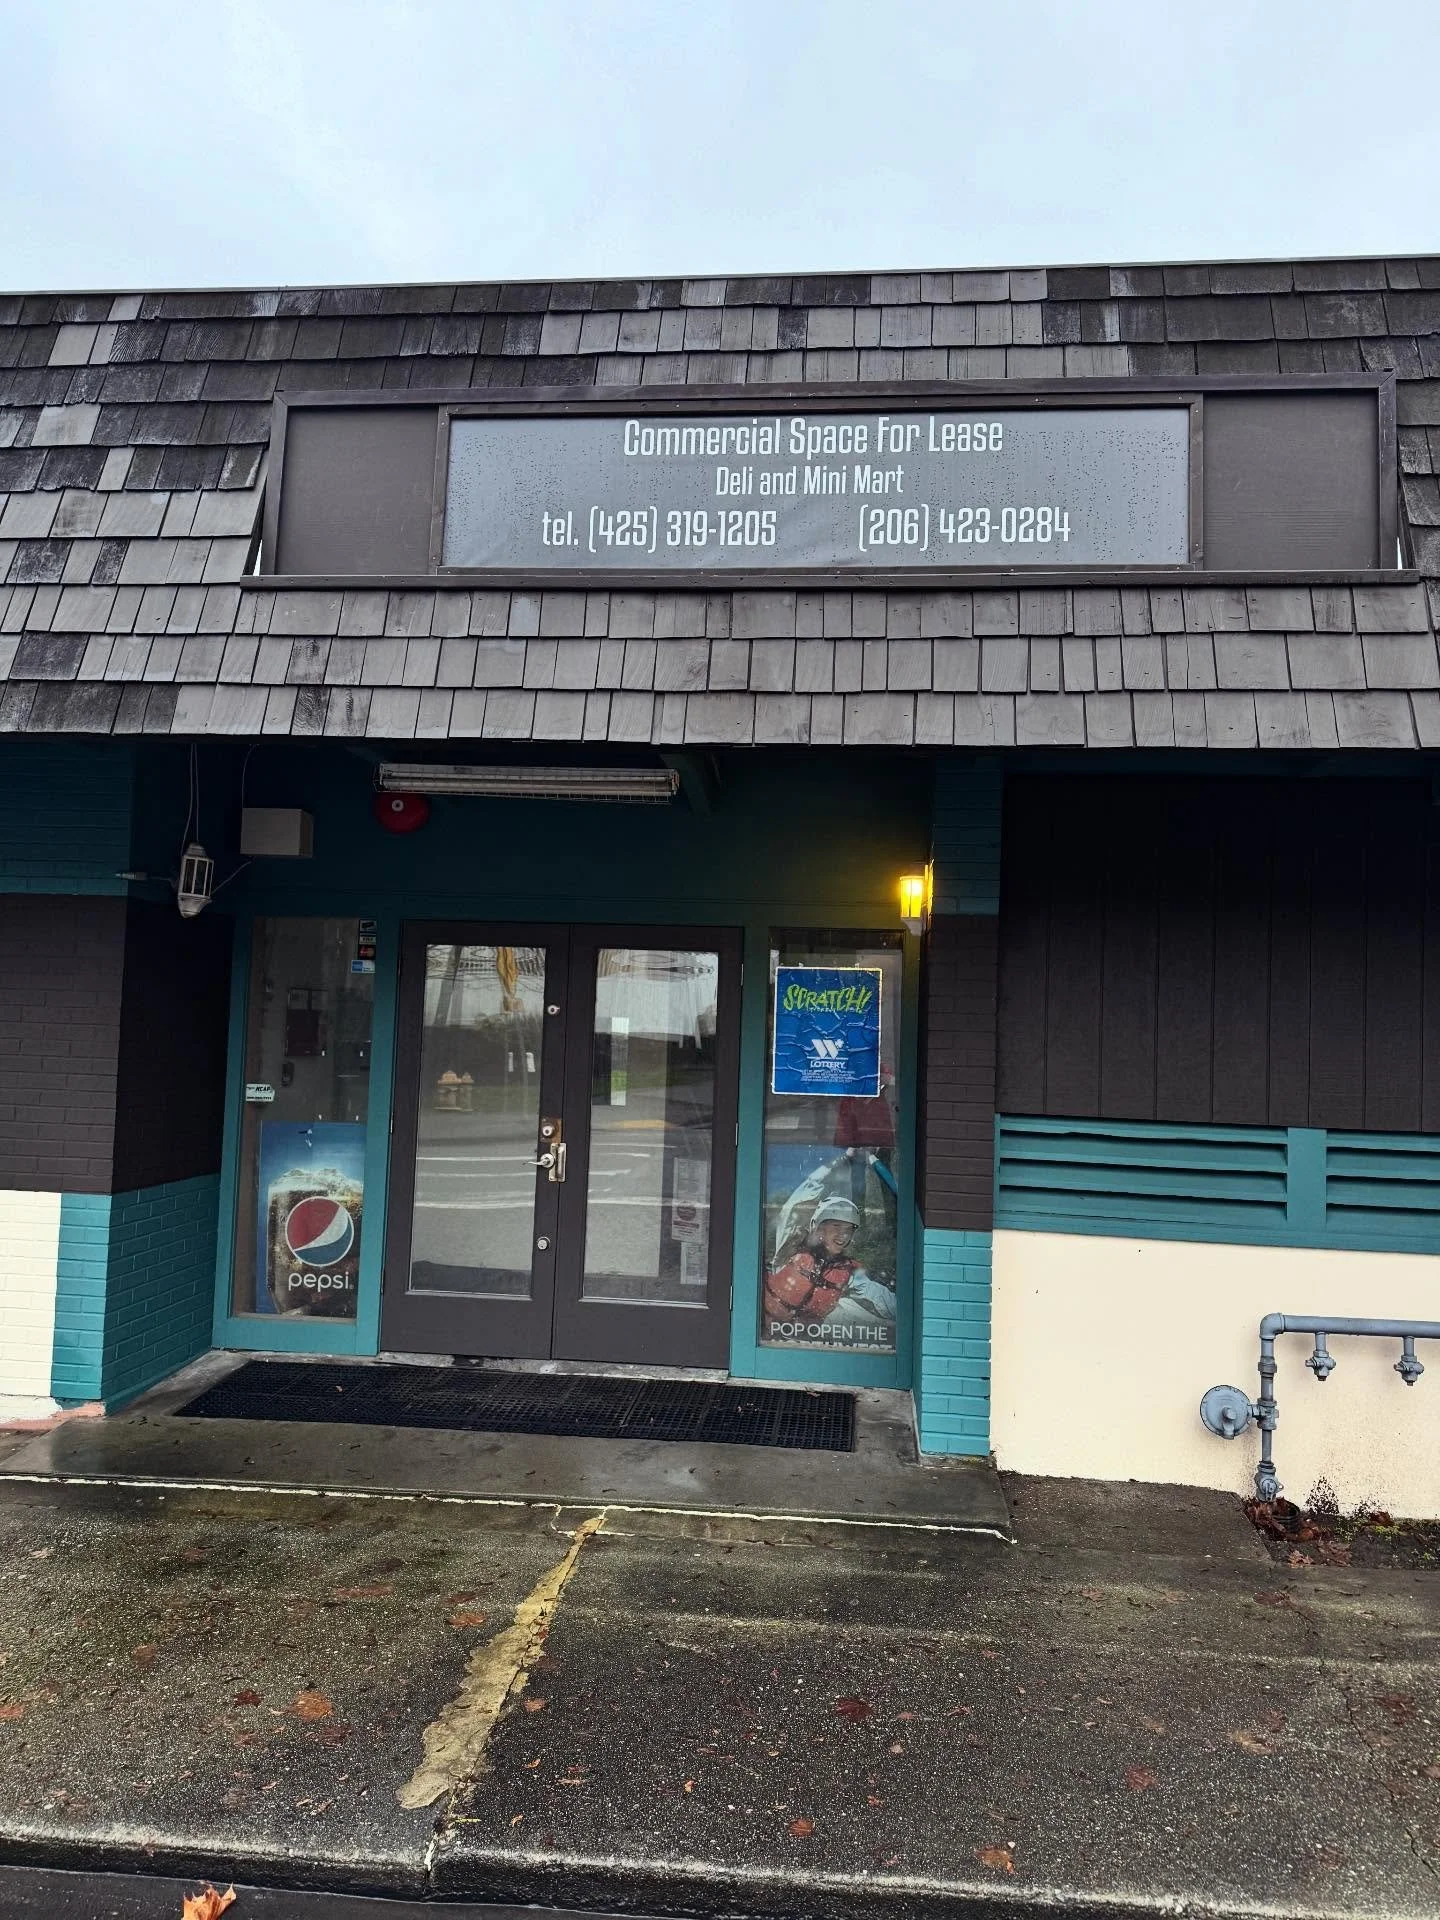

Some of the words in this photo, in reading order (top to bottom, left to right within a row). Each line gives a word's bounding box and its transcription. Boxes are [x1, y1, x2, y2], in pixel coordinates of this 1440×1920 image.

[623, 419, 781, 456] Commercial
[789, 417, 868, 460] Space
[877, 416, 920, 453] For
[929, 416, 1003, 452] Lease
[716, 467, 753, 496] Deli
[760, 466, 797, 495] and
[804, 465, 846, 495] Mini
[853, 464, 905, 493] Mart
[542, 511, 579, 546] tel.
[588, 506, 658, 553] (425)
[666, 511, 777, 546] 319-1205
[858, 504, 930, 552] (206)
[939, 506, 1071, 543] 423-0284
[783, 984, 873, 1014] SCRATCH!
[810, 1061, 846, 1069] LOTTERY
[288, 1271, 350, 1293] pepsi
[770, 1322, 805, 1337] POP
[807, 1323, 853, 1339] OPEN
[855, 1325, 888, 1341] THE
